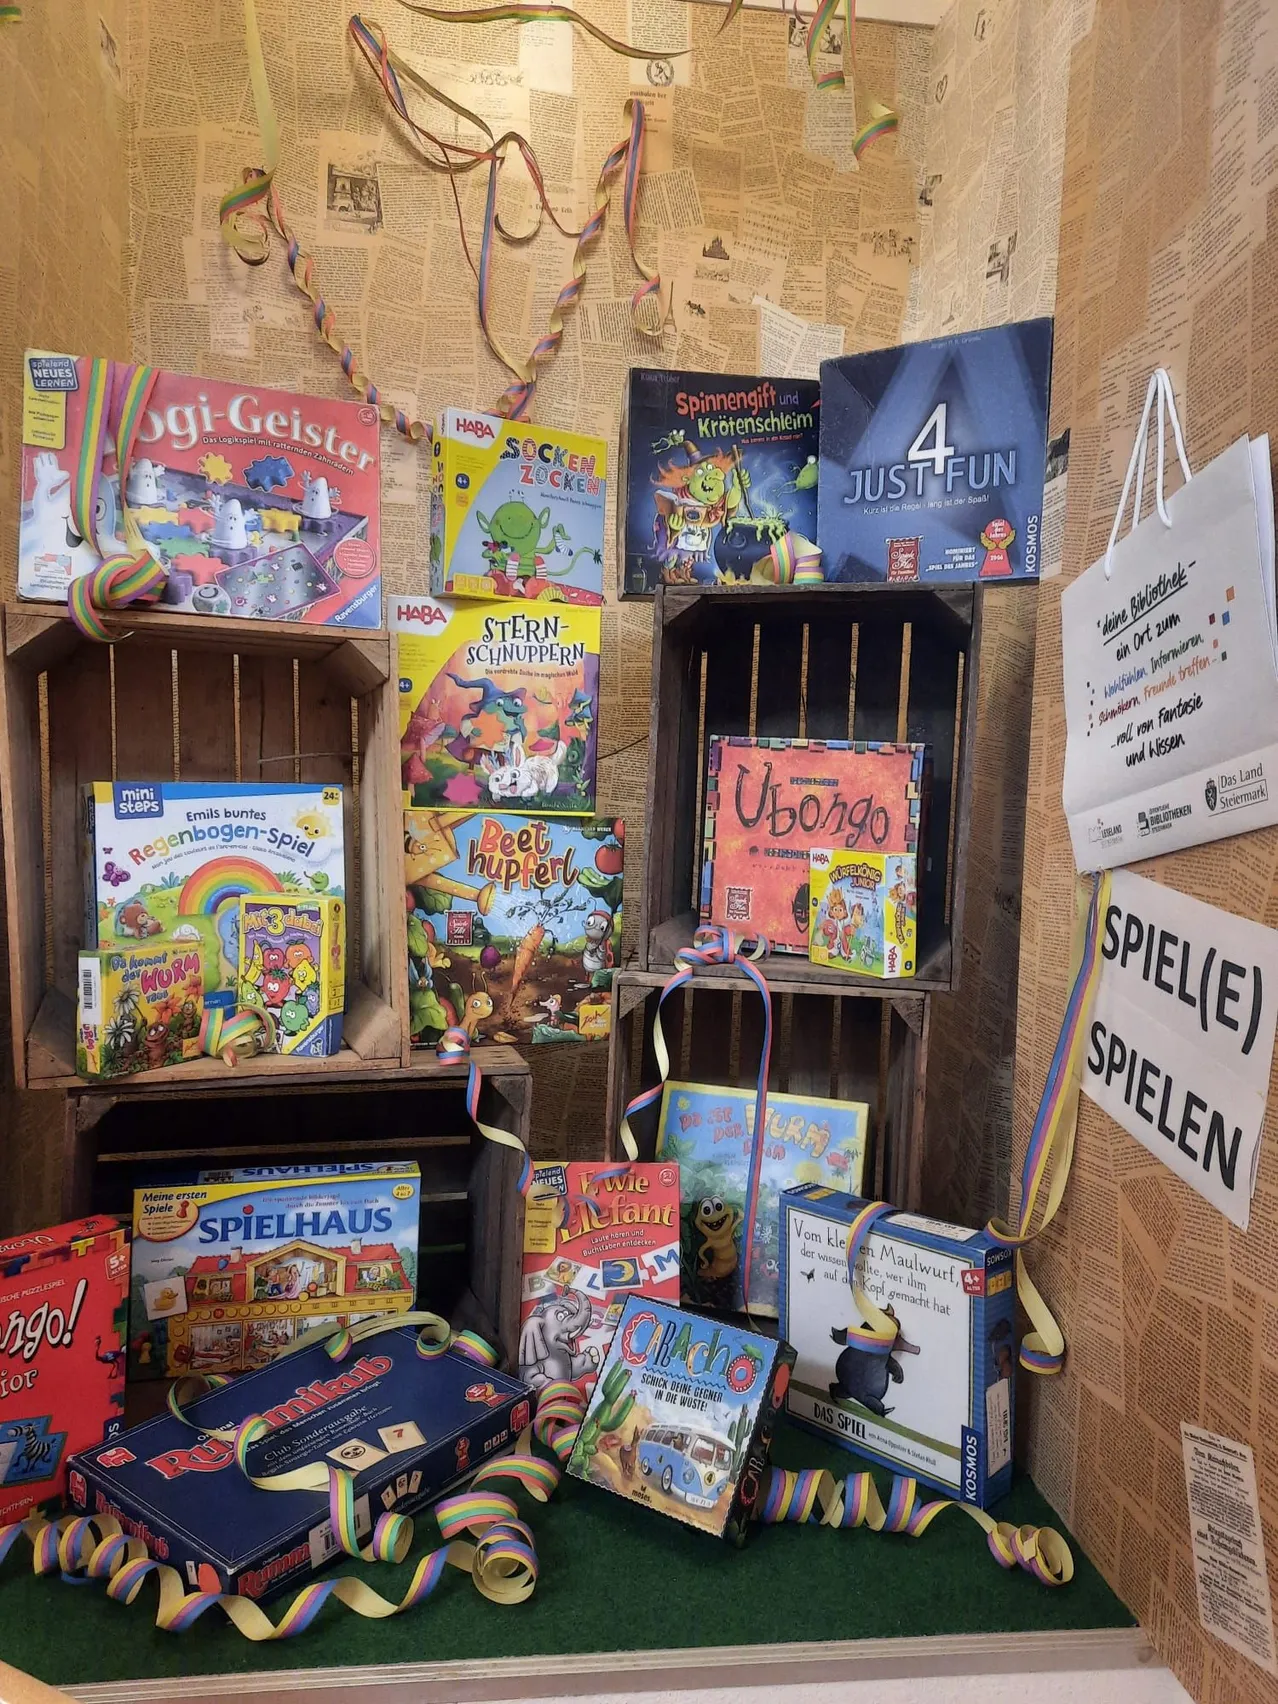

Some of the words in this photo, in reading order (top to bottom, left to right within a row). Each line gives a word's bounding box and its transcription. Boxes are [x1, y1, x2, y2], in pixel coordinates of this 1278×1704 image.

[32, 359, 69, 369] spielend
[33, 368, 73, 378] NEUES
[35, 378, 75, 388] LERNEN
[675, 382, 777, 420] Spinnengift
[779, 391, 799, 406] und
[103, 392, 376, 471] ogi-Geister
[456, 417, 495, 439] HABA
[697, 410, 813, 438] Krötenschleim
[202, 436, 217, 445] Das
[218, 436, 257, 446] Logikspiel
[258, 438, 271, 447] mit
[272, 442, 313, 457] ratternden
[500, 437, 596, 478] SOCKEN
[844, 462, 932, 504] JUST
[908, 403, 954, 475] 4
[946, 450, 1016, 492] FUN
[520, 464, 601, 497] ZOCKEN
[863, 506, 879, 515] Kurz
[880, 505, 888, 513] ist
[889, 504, 900, 512] die
[901, 502, 921, 512] Regel
[927, 500, 942, 510] lang
[944, 499, 953, 507] ist
[953, 497, 966, 506] der
[968, 494, 989, 505] Spaß!
[1025, 515, 1038, 573] KOSMOS
[334, 584, 378, 623] Ravensburger
[1102, 609, 1129, 636] deine
[1130, 562, 1187, 620] Bibliothek
[397, 604, 447, 625] HABA
[482, 613, 570, 644] STERN-
[1116, 642, 1131, 662] ein
[1133, 623, 1153, 651] Ort
[1155, 613, 1181, 638] zum
[466, 642, 585, 667] SCHNUPPERN
[1143, 671, 1177, 701] Freunde
[1136, 719, 1154, 737] von
[1158, 692, 1204, 728] Fantasie
[1125, 742, 1146, 768] und
[1149, 733, 1185, 758] Wissen
[1220, 774, 1237, 789] Das
[1239, 763, 1263, 783] Land
[119, 800, 160, 814] steps
[121, 788, 154, 801] mini
[734, 761, 891, 849] Ubongo
[1219, 785, 1266, 809] Steiermark
[186, 808, 220, 822] Emils
[224, 808, 267, 821] buntes
[1150, 804, 1192, 826] BIBLIOTHEKEN
[128, 823, 316, 866] Regenbogen-Spiel
[478, 817, 553, 858] Beet
[1101, 825, 1122, 839] LESELAND
[467, 846, 579, 893] hupferl
[812, 852, 830, 865] HABA
[829, 862, 883, 884] WÜRFELKÖNIG
[850, 877, 876, 892] JUNIOR
[243, 908, 270, 934] Mit
[266, 906, 286, 936] 3
[284, 907, 324, 937] dabei
[111, 956, 127, 972] Da
[129, 951, 168, 970] kommt
[888, 945, 898, 973] HABA
[121, 969, 141, 983] der
[141, 952, 200, 995] WURM
[1101, 904, 1263, 1055] SPIEL(E)
[1087, 1021, 1243, 1192] SPIELEN
[744, 1103, 832, 1159] WURM
[534, 1166, 561, 1180] pielend
[578, 1170, 600, 1197] E
[604, 1170, 649, 1193] wie
[141, 1192, 174, 1202] Meine
[175, 1191, 207, 1201] ersten
[143, 1203, 174, 1215] Spiele
[582, 1240, 621, 1257] Buchstaben
[622, 1239, 656, 1248] entdecken
[591, 1234, 610, 1245] Laute
[610, 1230, 630, 1240] hören
[630, 1229, 644, 1237] und
[109, 1254, 126, 1270] 5+
[793, 1218, 822, 1244] Vom
[827, 1227, 876, 1259] kleen
[879, 1244, 960, 1288] Maulwurf,
[800, 1242, 815, 1259] der
[817, 1251, 848, 1269] wissen
[885, 1271, 903, 1284] wer
[906, 1272, 928, 1293] ihm
[963, 1272, 980, 1285] 4+
[21, 1278, 66, 1298] PUZZLESPIEL
[586, 1272, 600, 1291] L
[823, 1268, 838, 1283] auf
[860, 1273, 886, 1302] Kopf
[888, 1289, 931, 1309] gemacht
[932, 1297, 951, 1317] hat
[640, 1373, 668, 1389] SCHICK
[670, 1381, 692, 1397] DEINE
[694, 1386, 723, 1403] GEGNER
[654, 1389, 663, 1400] IN
[664, 1393, 678, 1404] DIE
[678, 1396, 708, 1412] WÜSTE!
[144, 1355, 393, 1480] Rumikub
[292, 1409, 327, 1429] Menschen
[813, 1402, 834, 1424] DAS
[837, 1412, 867, 1440] SPIEL
[264, 1444, 292, 1462] Club
[292, 1405, 367, 1447] Sonderausgabe
[706, 1473, 713, 1483] 4
[965, 1435, 977, 1501] KOSMOS
